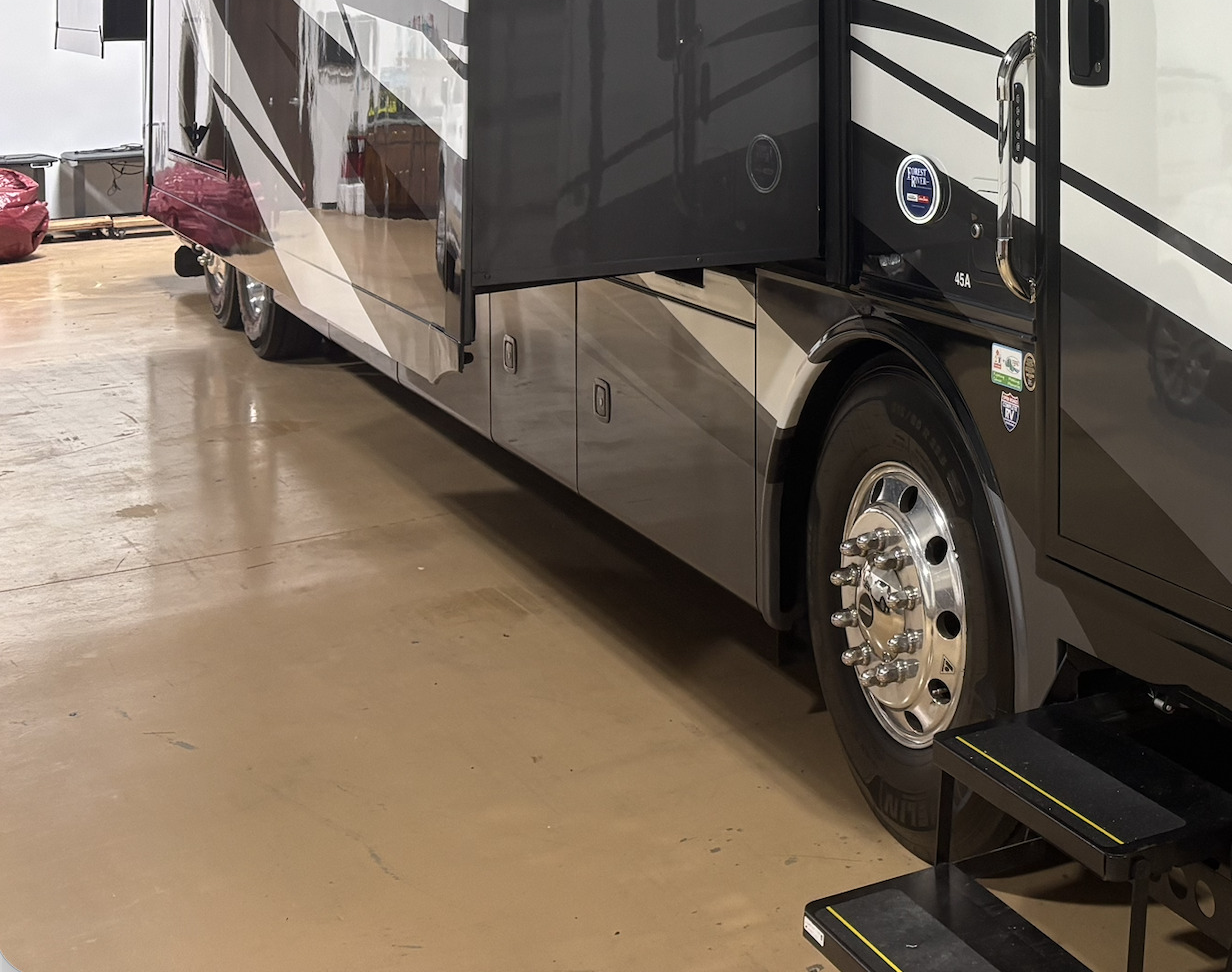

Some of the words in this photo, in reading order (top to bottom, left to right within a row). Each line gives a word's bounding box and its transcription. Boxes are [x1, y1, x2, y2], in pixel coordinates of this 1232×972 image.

[906, 166, 928, 179] FOREST
[911, 175, 927, 188] RIVER
[954, 271, 971, 288] 45A
[1004, 407, 1015, 421] RV
